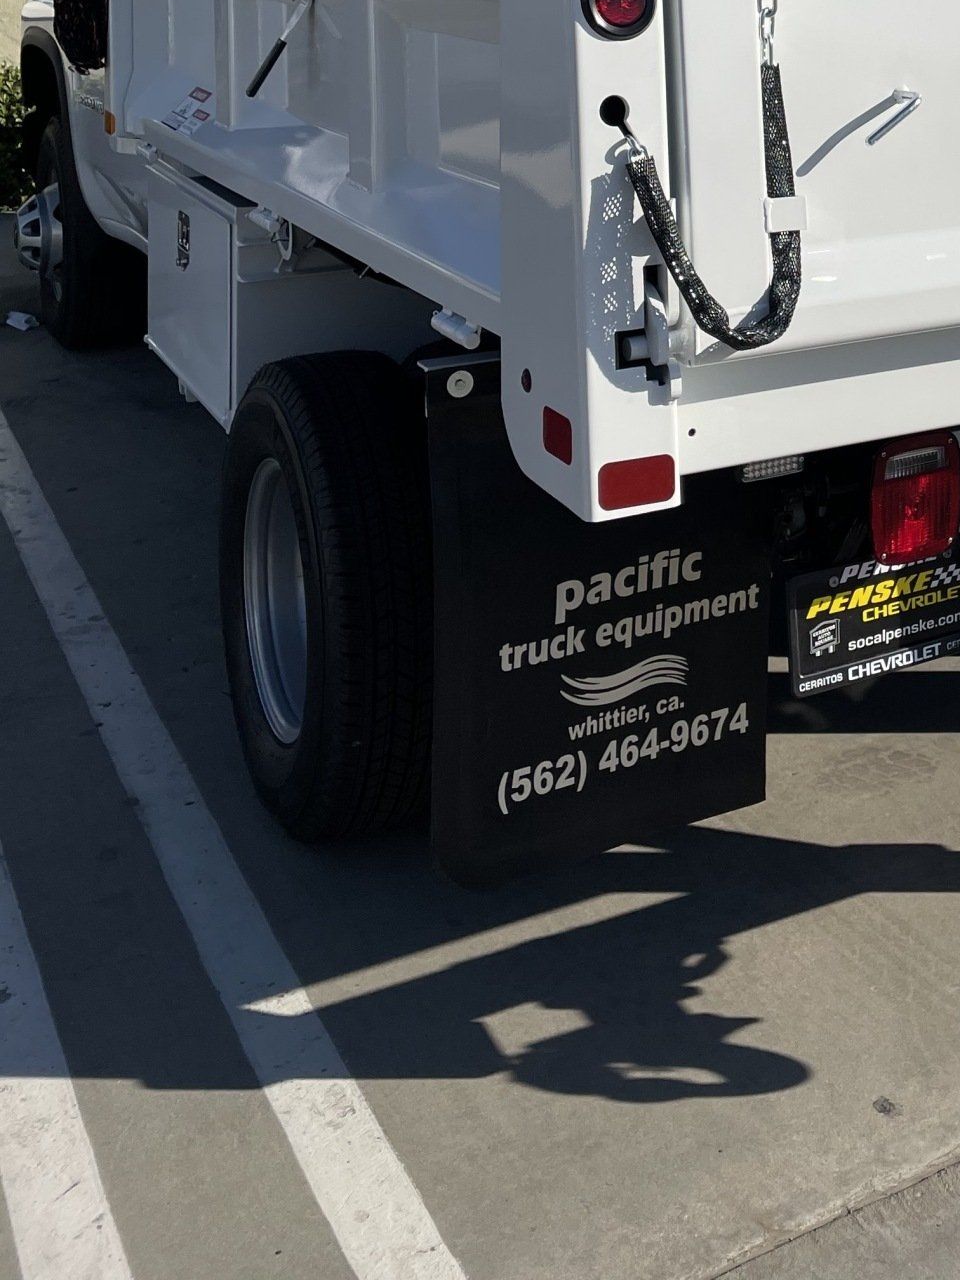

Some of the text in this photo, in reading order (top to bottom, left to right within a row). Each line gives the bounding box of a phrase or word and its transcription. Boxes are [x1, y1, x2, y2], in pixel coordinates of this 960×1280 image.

[554, 548, 703, 625] pacific
[805, 569, 932, 620] PENSKE
[499, 583, 760, 672] truck equipment
[799, 672, 844, 693] CERRITOS
[847, 642, 942, 681] CHEVROLET
[567, 695, 685, 741] whittier, ca.
[497, 702, 749, 815] (562) 464-9674
